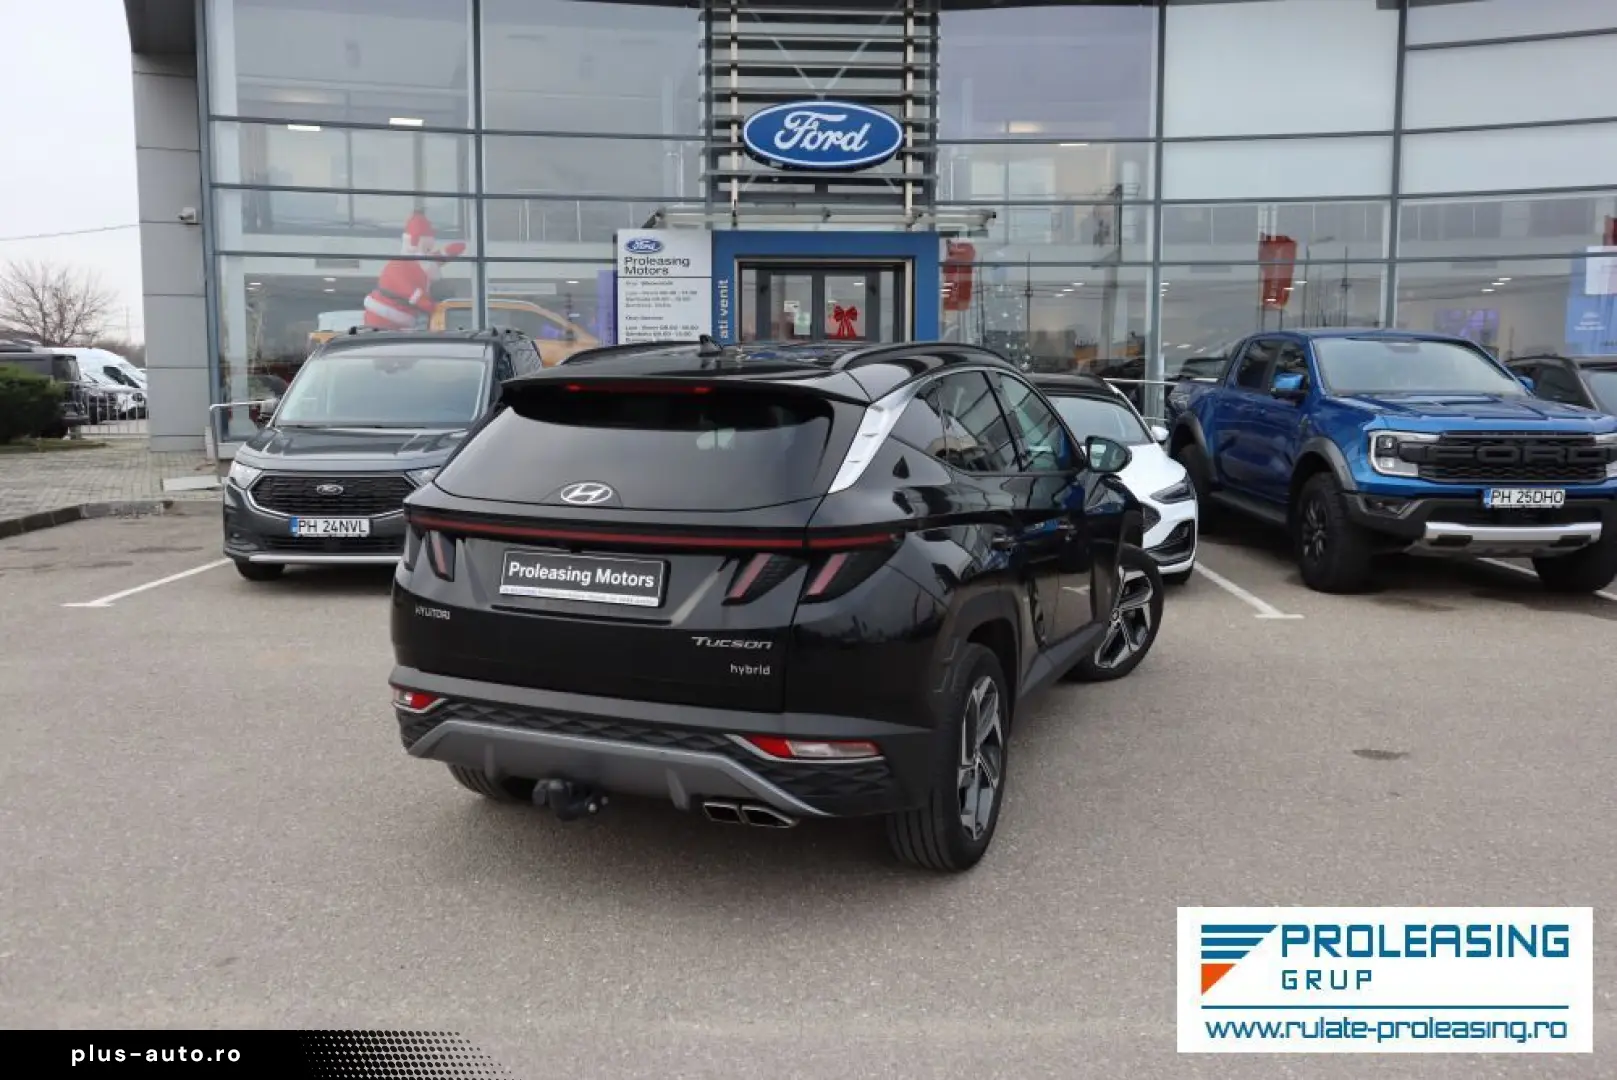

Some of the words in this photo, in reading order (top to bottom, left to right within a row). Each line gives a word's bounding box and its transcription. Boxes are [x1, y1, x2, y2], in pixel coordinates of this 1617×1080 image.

[774, 110, 872, 152] Ford
[624, 256, 691, 267] Proleasing
[624, 266, 669, 276] Motors
[717, 279, 729, 316] venit
[1426, 445, 1608, 464] FORD
[1491, 489, 1511, 504] PH
[1516, 489, 1564, 505] 25DHO
[299, 520, 318, 533] PH
[322, 520, 367, 533] 24NVL
[508, 561, 592, 586] Proleasing
[595, 567, 655, 588] Motors
[730, 663, 771, 676] hybrid
